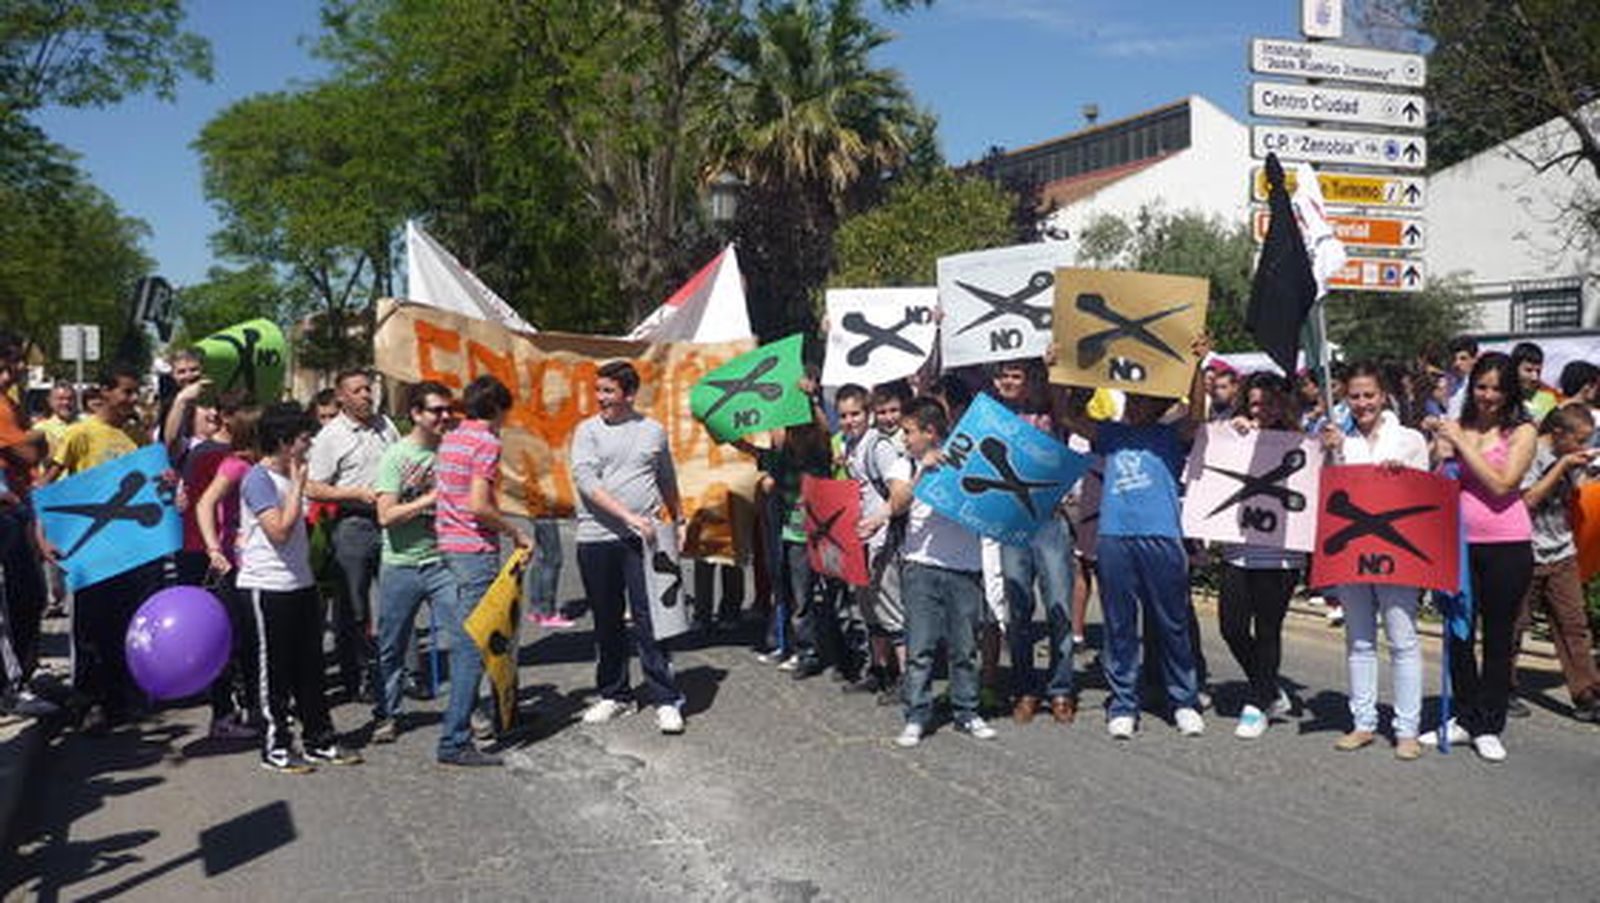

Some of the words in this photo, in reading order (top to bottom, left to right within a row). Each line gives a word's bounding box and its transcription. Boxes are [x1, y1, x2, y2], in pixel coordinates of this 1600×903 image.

[1262, 90, 1309, 110] Centro
[1311, 93, 1359, 115] Ciudad
[904, 304, 932, 326] NO
[989, 326, 1024, 352] NO
[256, 345, 281, 368] NO
[1108, 355, 1147, 382] NO
[732, 407, 761, 430] NO
[937, 432, 975, 471] NO
[1239, 505, 1278, 534] NO
[1357, 552, 1396, 577] NO
